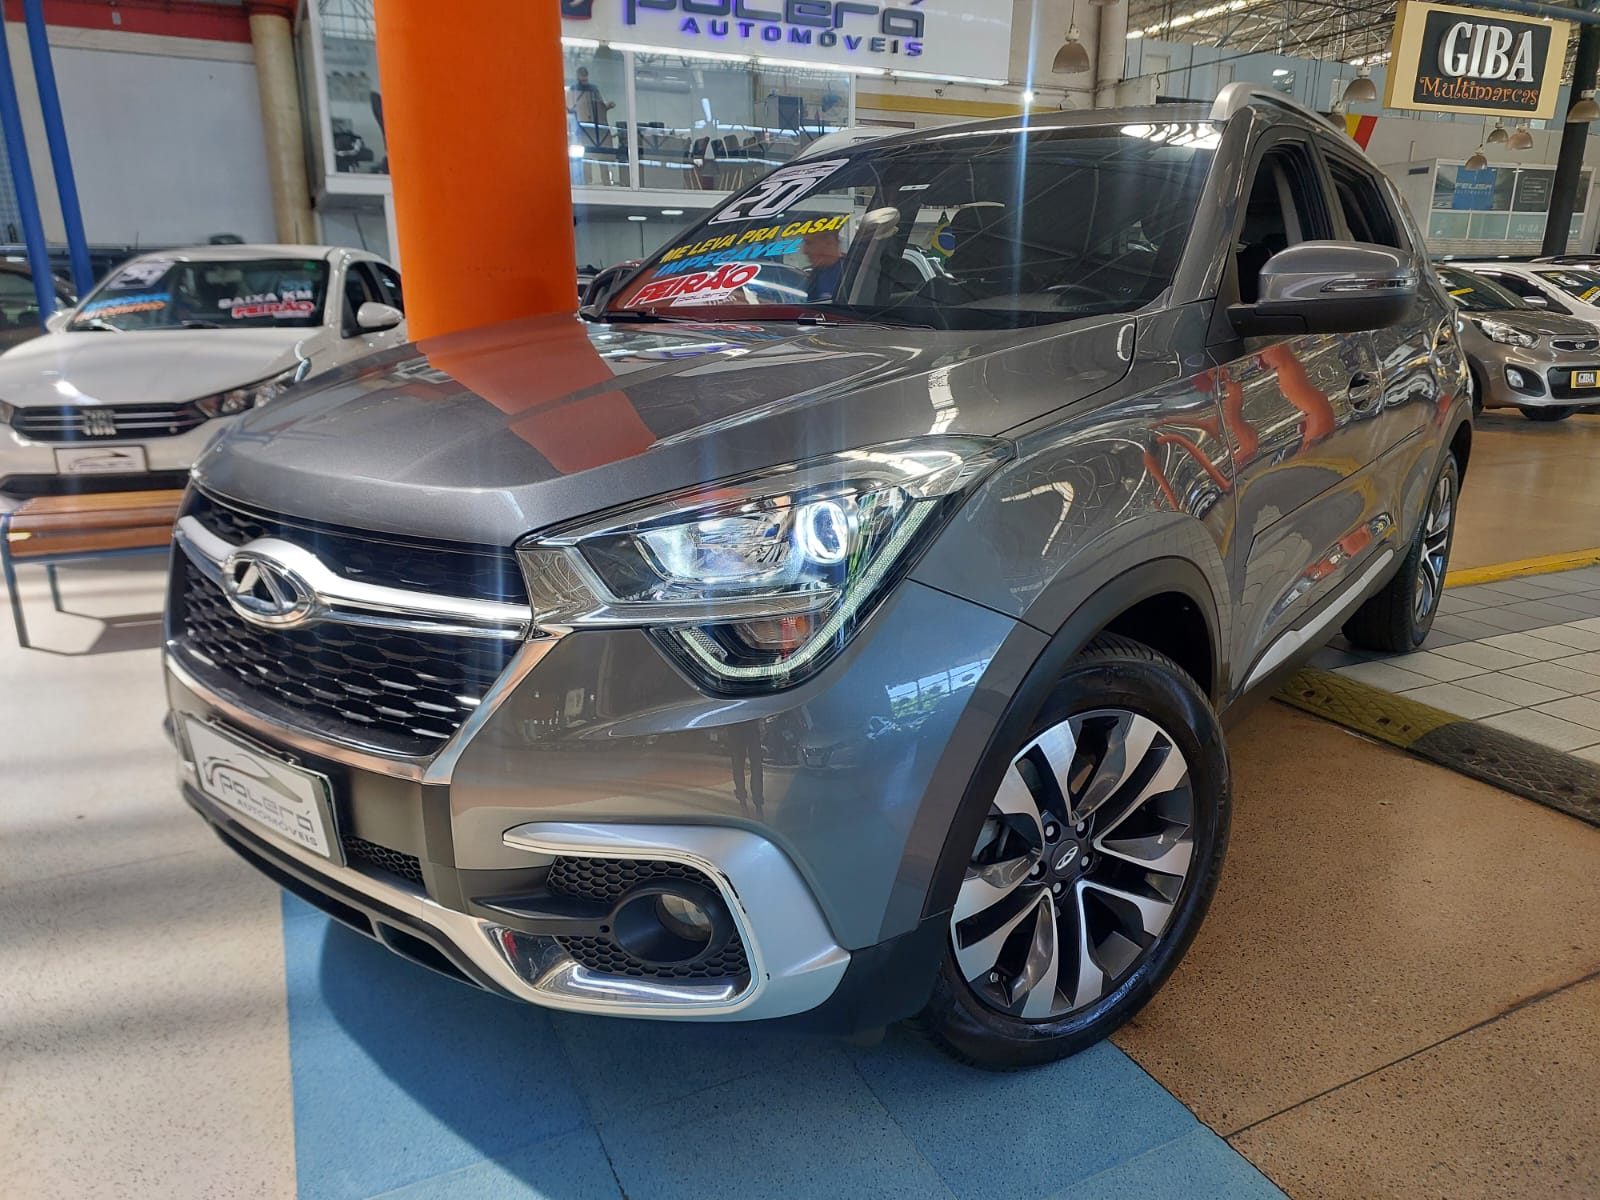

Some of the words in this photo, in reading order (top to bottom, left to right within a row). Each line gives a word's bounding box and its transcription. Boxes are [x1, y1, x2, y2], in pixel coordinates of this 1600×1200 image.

[681, 16, 923, 57] AUTOMÓVEIS
[1441, 21, 1534, 82] GIBA
[1419, 76, 1538, 105] Multimarcas
[717, 177, 817, 221] 20
[652, 238, 804, 279] IMPECÁVEL
[659, 244, 691, 264] ME
[690, 231, 740, 255] LEVA
[738, 226, 780, 243] PRA
[781, 214, 850, 238] CASA!
[626, 263, 760, 307] FEIRÃO
[1577, 373, 1595, 384] GIBA
